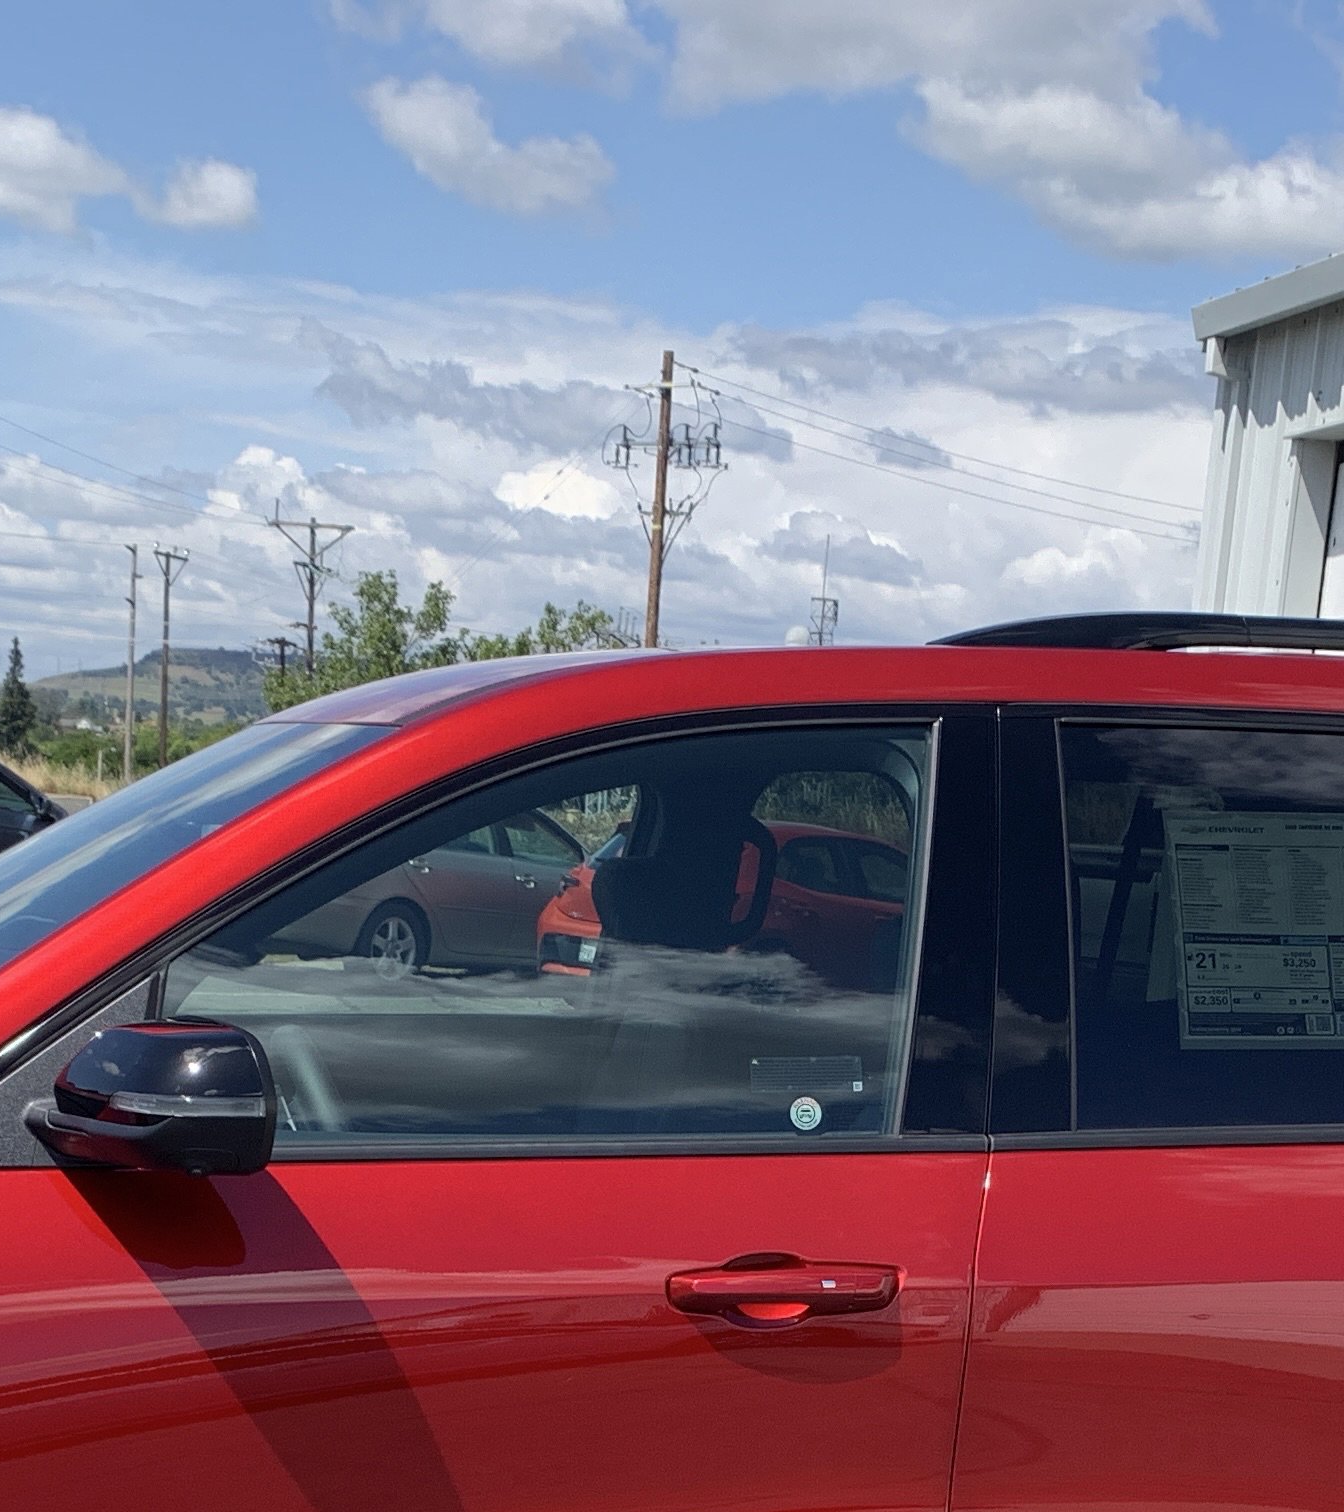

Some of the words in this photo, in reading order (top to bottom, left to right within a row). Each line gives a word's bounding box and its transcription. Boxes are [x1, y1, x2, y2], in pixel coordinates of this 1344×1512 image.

[1208, 825, 1265, 834] CHEVROLET
[1195, 951, 1217, 970] 21
[1283, 958, 1316, 968] $3,250
[1193, 995, 1229, 1006] $2,350
